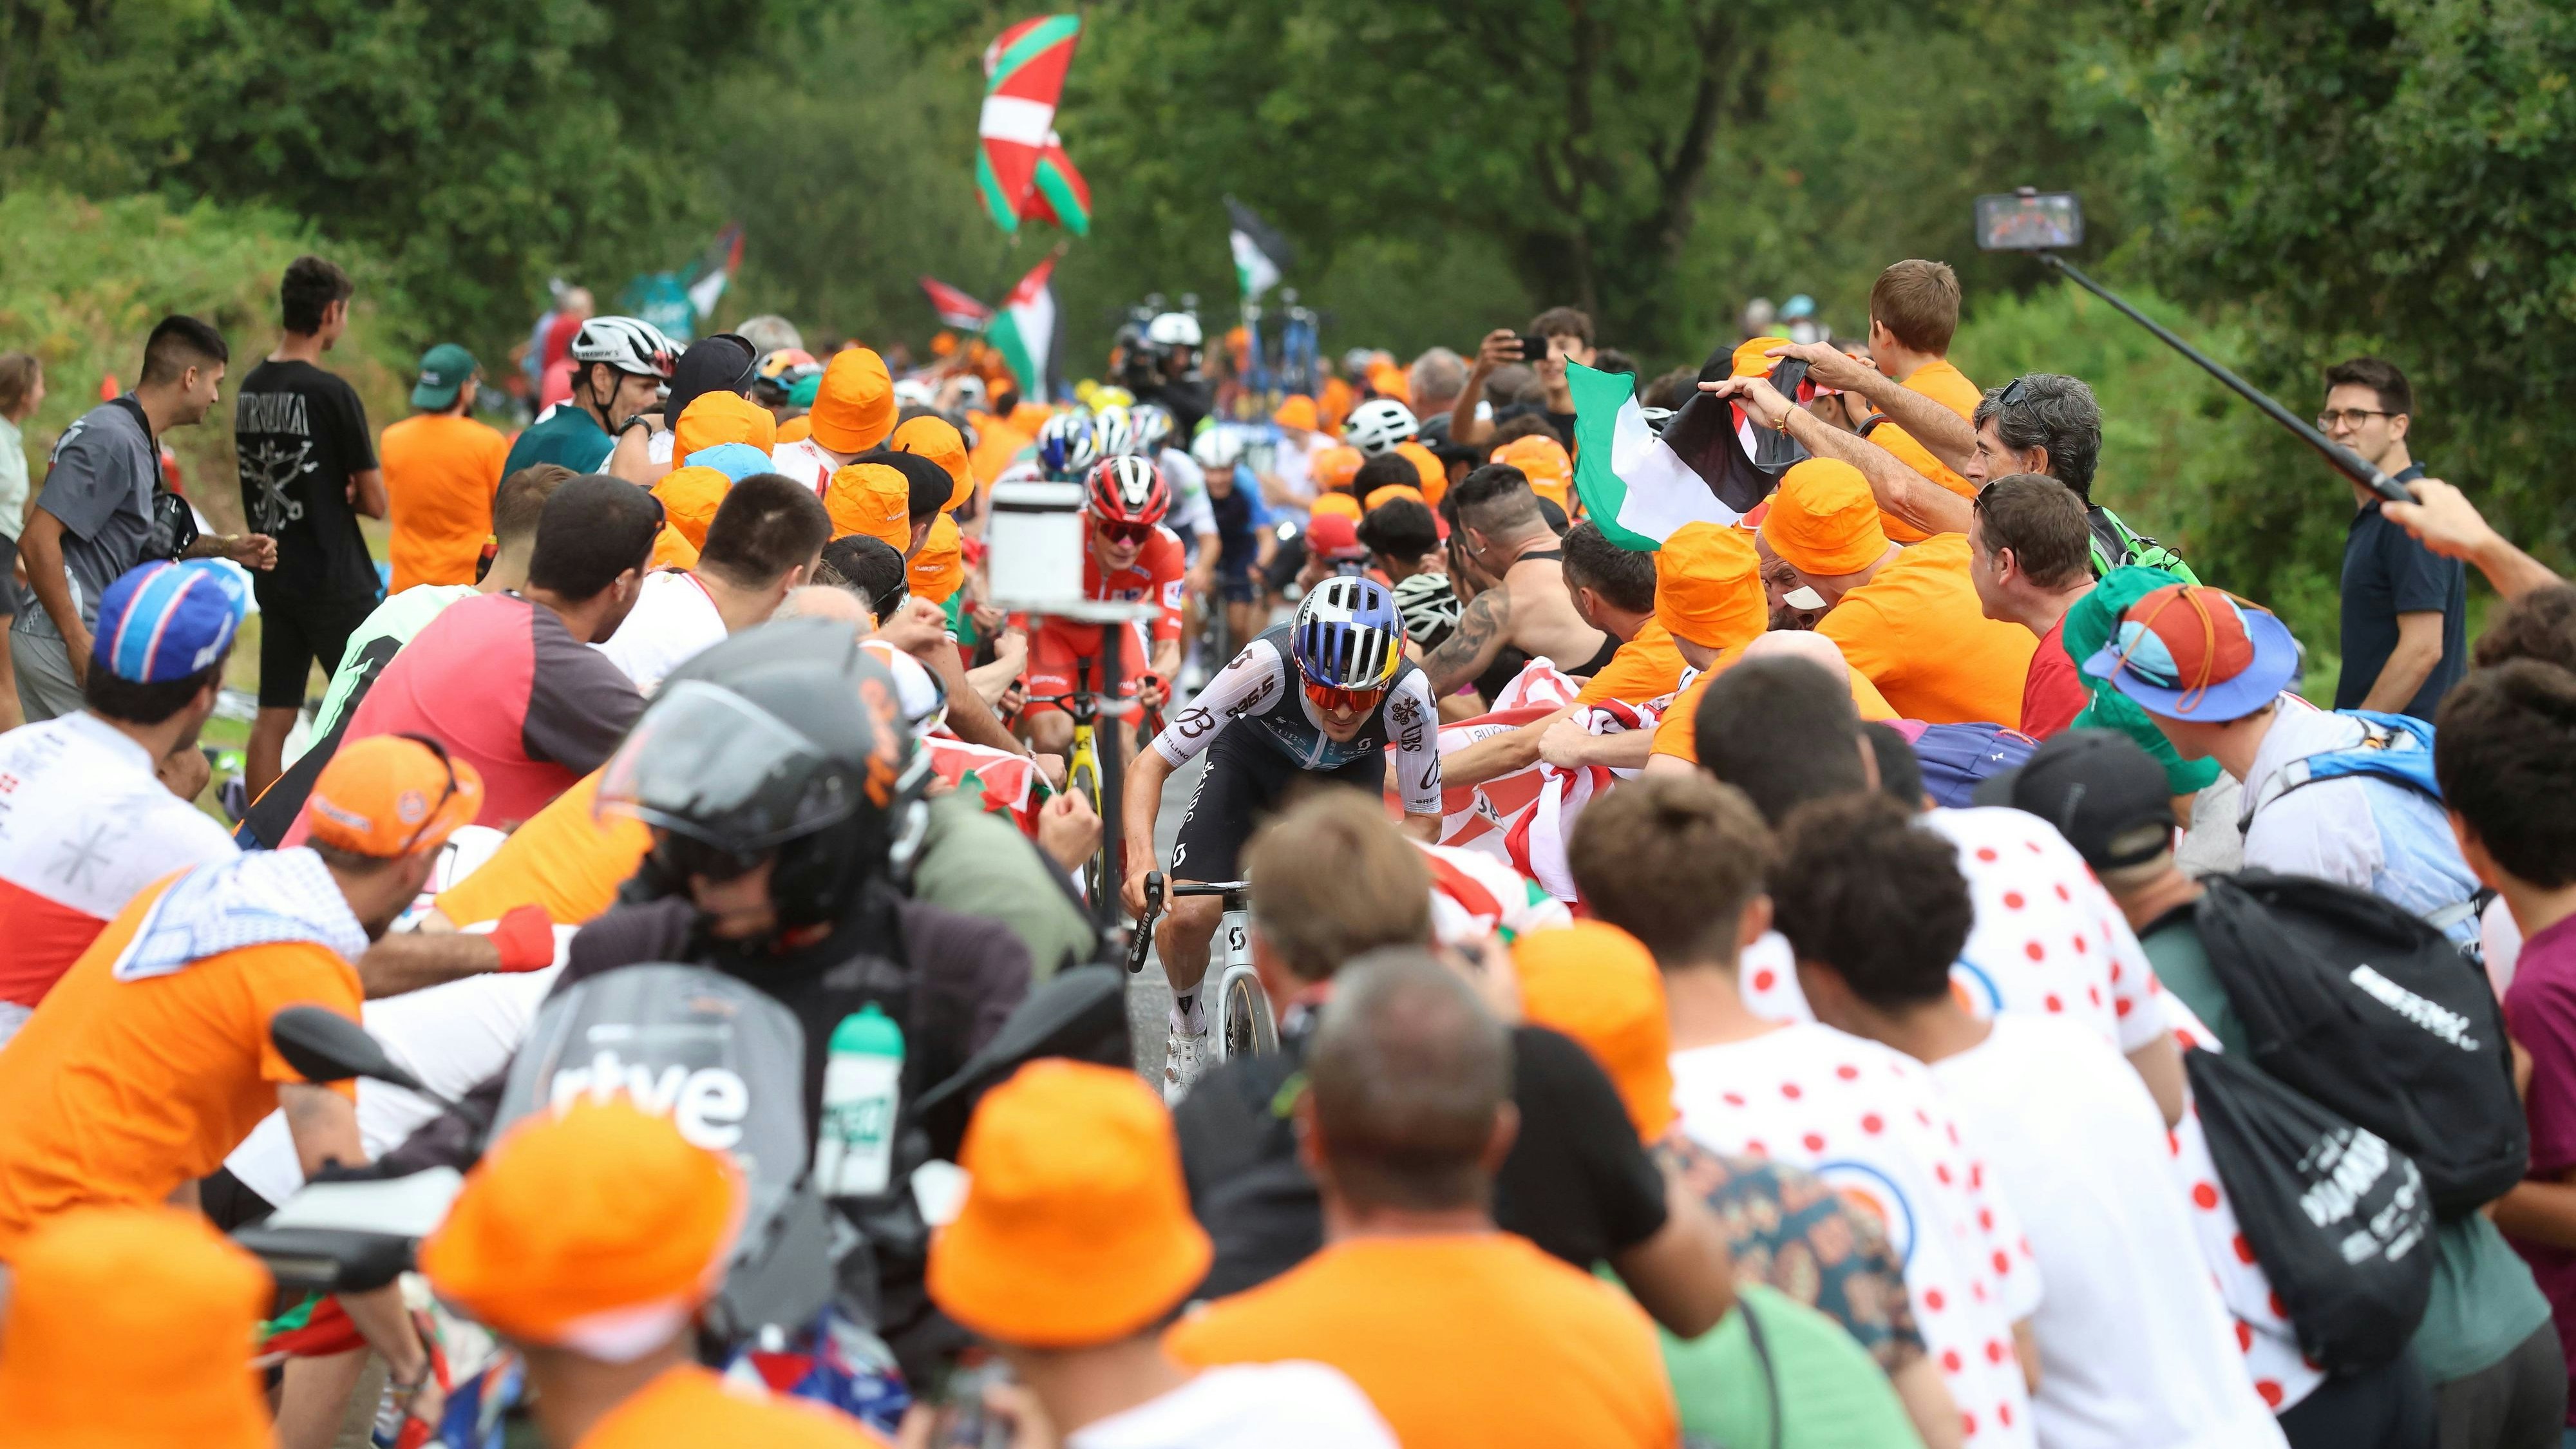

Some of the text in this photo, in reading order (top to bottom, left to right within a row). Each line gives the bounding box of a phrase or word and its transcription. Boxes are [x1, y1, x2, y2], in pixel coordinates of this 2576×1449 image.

[1278, 728, 1307, 746] UBS
[1402, 723, 1423, 752] UBS
[1416, 793, 1440, 804] BREIT
[1132, 912, 1151, 953] SRAM
[551, 1050, 749, 1151] rtve
